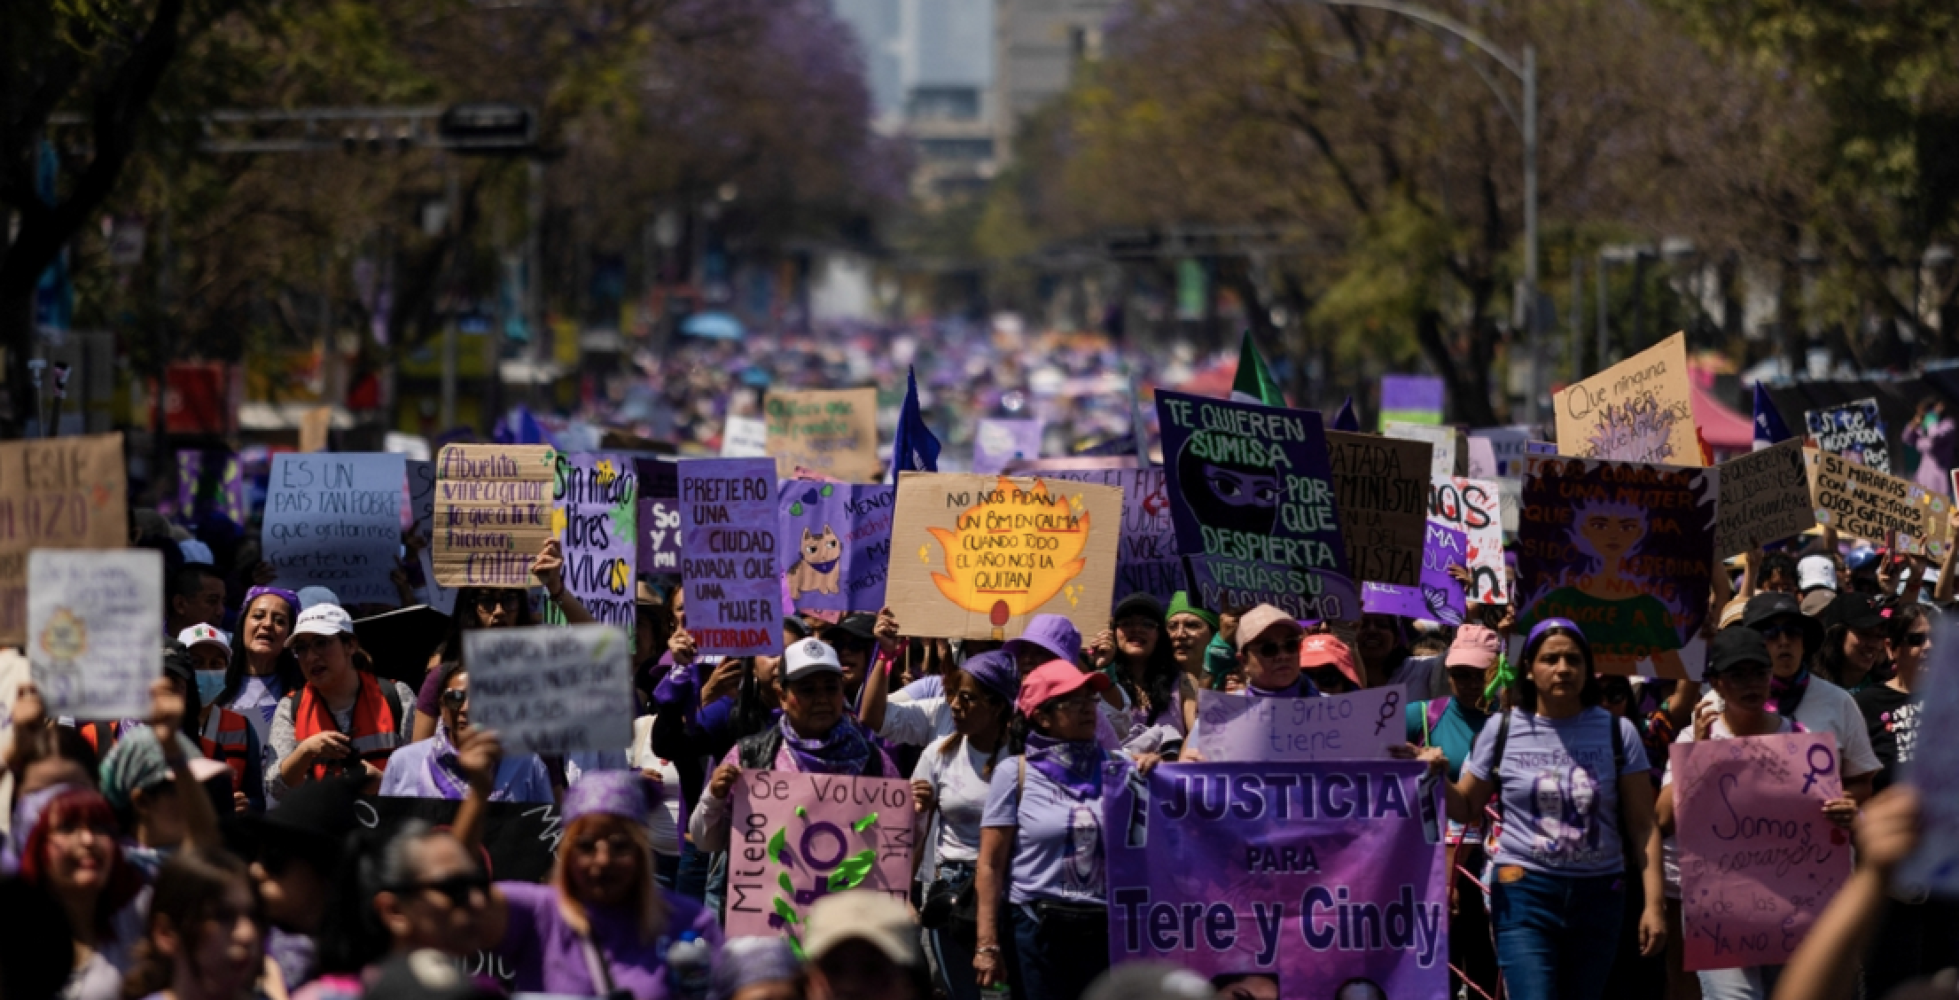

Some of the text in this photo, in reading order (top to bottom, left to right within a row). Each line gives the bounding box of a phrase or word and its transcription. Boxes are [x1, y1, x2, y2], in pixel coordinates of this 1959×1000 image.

[1568, 384, 1606, 420] Que
[1613, 361, 1666, 396] ninguna
[1164, 398, 1307, 443] TE QUIEREN
[1189, 428, 1293, 469] SUMISA
[282, 460, 354, 490] ES UN
[443, 446, 519, 478] Abuelita
[1527, 458, 1690, 487] TODOS CONOCEN
[553, 455, 635, 505] Sin miedo
[683, 477, 768, 503] PREFIERO
[1825, 456, 1844, 476] SI
[1846, 465, 1906, 499] MIRARAS
[317, 490, 347, 514] TAN
[350, 489, 401, 517] POBRE
[946, 488, 1056, 508] NO NOS PIDAN
[1533, 477, 1696, 512] A UNA MUJER
[1818, 474, 1847, 493] CON
[1852, 487, 1922, 521] NUESTROS
[1818, 490, 1855, 515] OJOS
[467, 507, 493, 528] que
[692, 504, 730, 525] UNA
[956, 510, 1079, 531] UN 8M EN CALMA
[1281, 502, 1337, 533] QUE
[1366, 510, 1382, 528] LA
[1523, 503, 1573, 523] QUE
[270, 520, 309, 546] que
[708, 530, 775, 554] CIUDAD
[962, 533, 1060, 550] CUANDO TODO
[1200, 524, 1337, 568] DESPIERTA
[270, 550, 369, 569] fuerte un
[956, 551, 1055, 569] EL AÑO NOS LA
[1523, 538, 1579, 562] SIDO
[683, 557, 776, 580] RAYADA QUE
[974, 571, 1033, 590] QUITAN
[1206, 559, 1325, 595] VERÍAS SU
[695, 583, 726, 600] UNA
[1605, 577, 1677, 602] NADIE
[718, 599, 773, 624] MUJER
[1532, 599, 1618, 626] CONOCE
[1632, 608, 1649, 628] A
[1292, 698, 1353, 726] grito
[1268, 728, 1342, 753] tiene
[751, 770, 907, 808] Se Volvio
[1159, 773, 1412, 821] JUSTICIA
[1712, 773, 1812, 843] Somos
[1246, 845, 1321, 875] PARA
[1712, 890, 1815, 915] de las que
[1114, 884, 1444, 970] Tere y Cindy
[1739, 931, 1769, 952] NO
